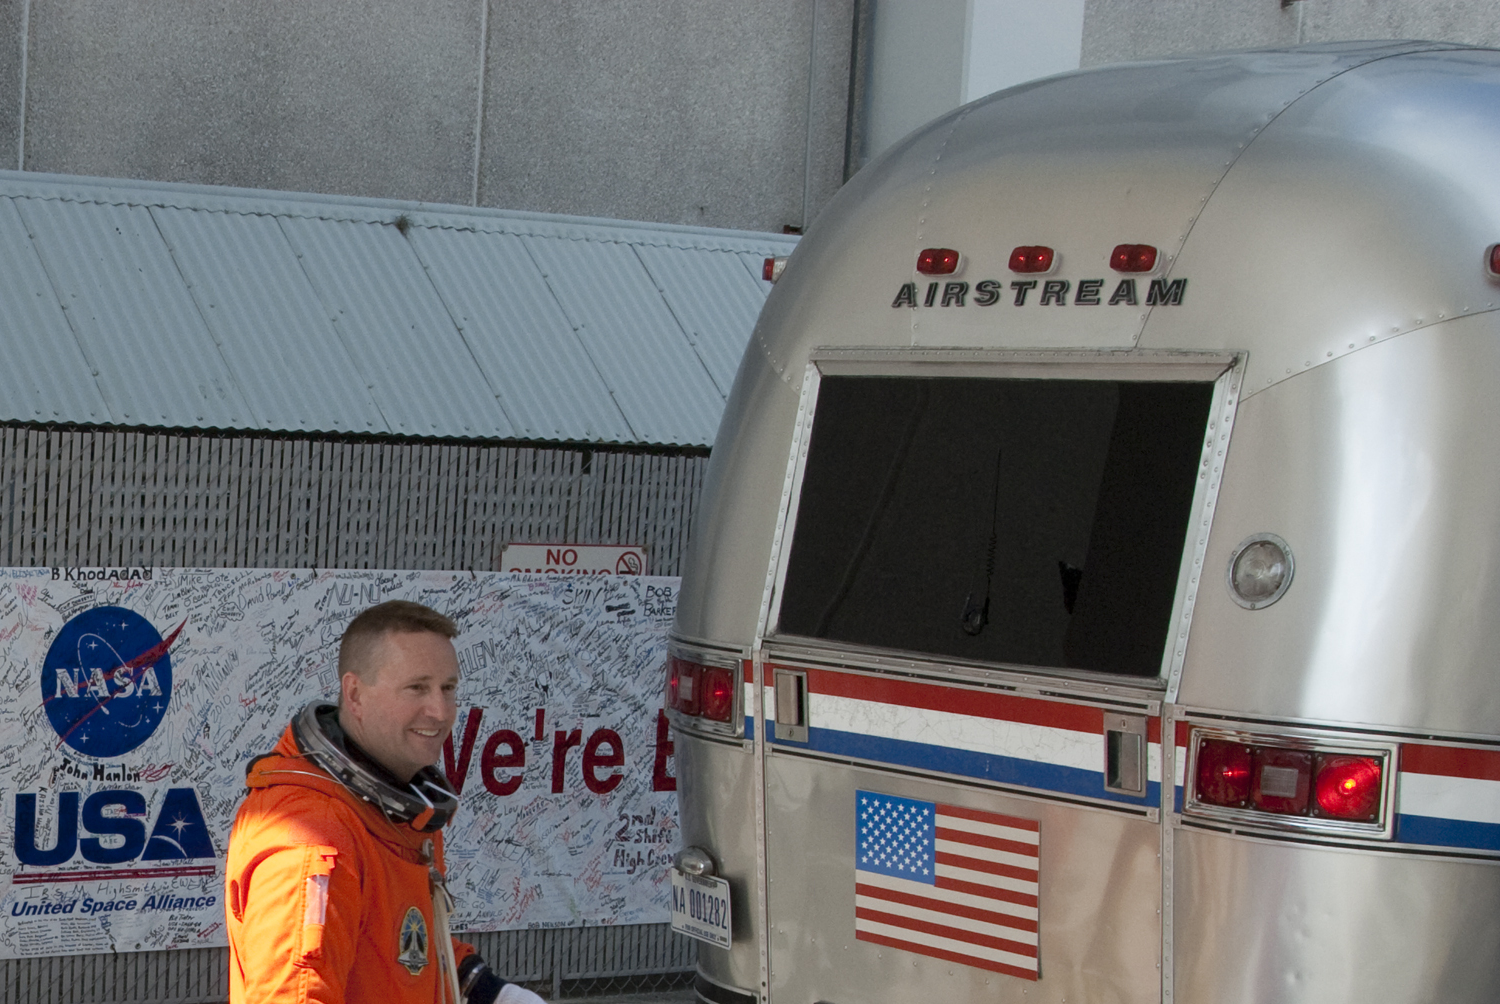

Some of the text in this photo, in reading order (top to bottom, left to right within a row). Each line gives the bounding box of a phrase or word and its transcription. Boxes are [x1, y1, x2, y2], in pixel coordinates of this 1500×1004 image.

[892, 278, 1188, 308] AIRSTREAM
[546, 549, 578, 566] NO
[51, 567, 61, 581] B
[646, 585, 672, 598] BOB
[55, 667, 163, 698] NASA
[60, 758, 88, 780] John
[93, 763, 141, 782] Hanlon
[14, 788, 217, 867] USA
[615, 806, 656, 843] 2nd
[613, 849, 645, 875] High
[12, 900, 79, 917] United
[80, 898, 138, 916] Space
[141, 894, 217, 911] Alliance
[673, 885, 727, 930] NA 001282
